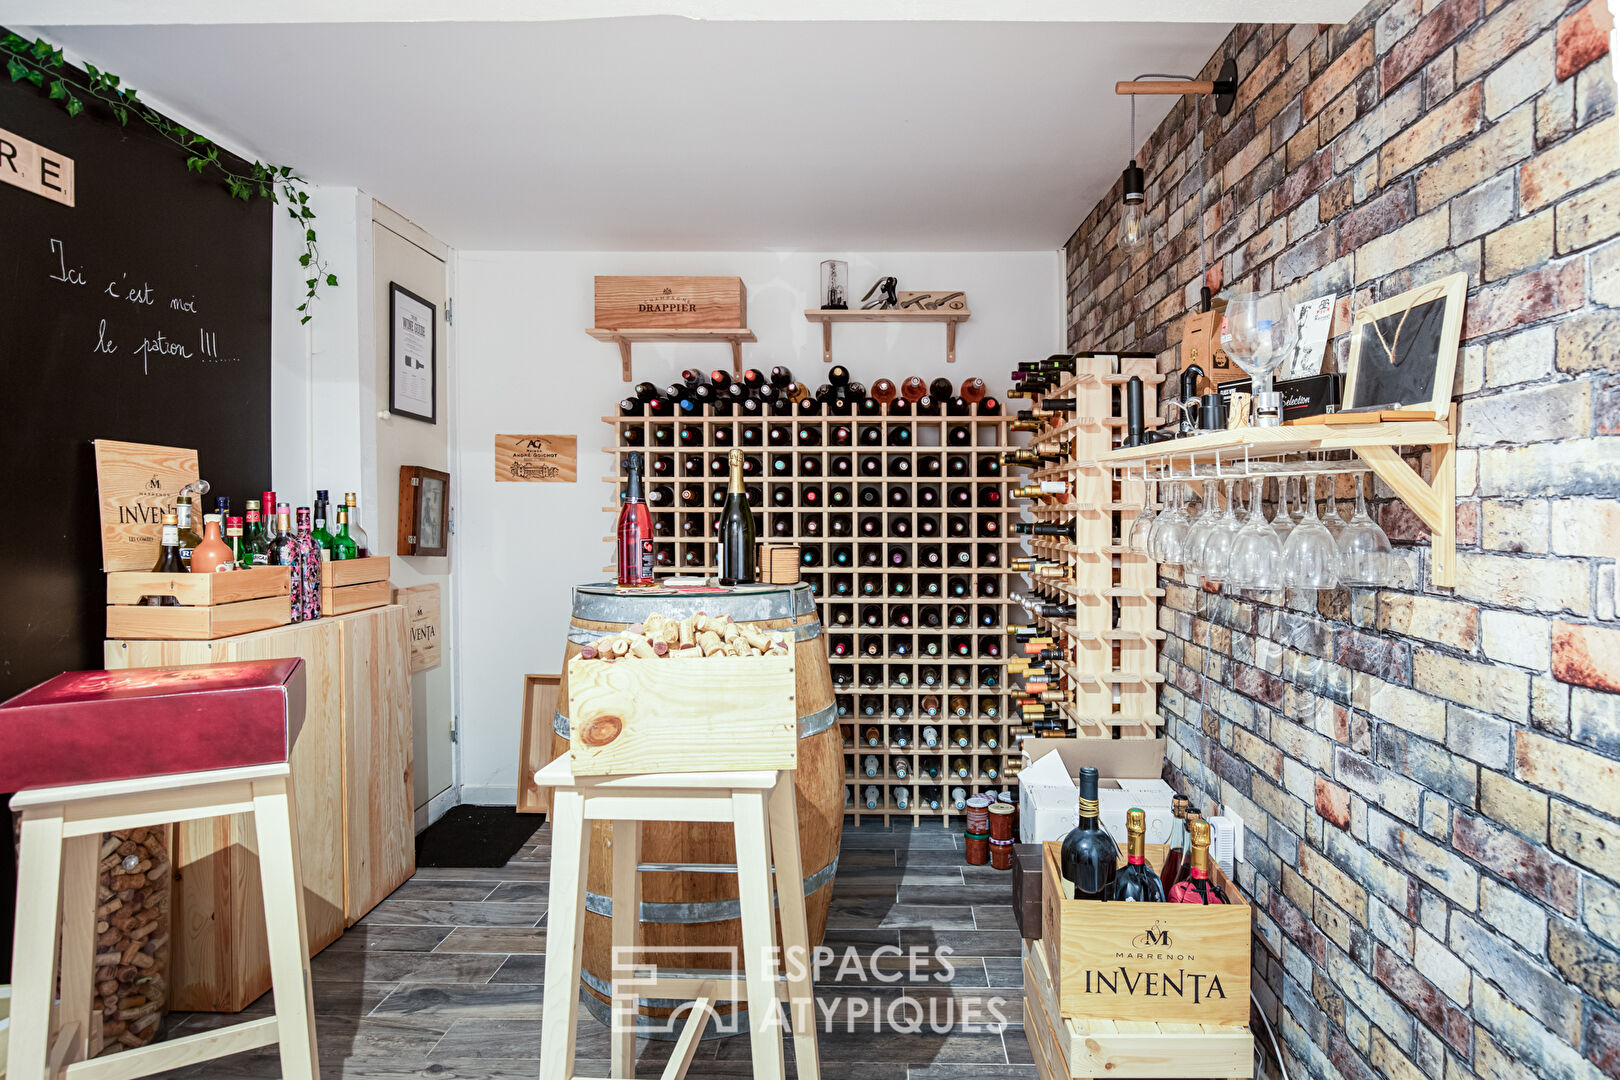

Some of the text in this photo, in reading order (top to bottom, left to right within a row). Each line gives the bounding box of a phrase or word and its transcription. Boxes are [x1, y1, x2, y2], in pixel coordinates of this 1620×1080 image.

[49, 238, 197, 314] Ici c'est moi
[638, 303, 697, 313] DRAPPIER
[93, 318, 118, 354] le
[1115, 951, 1196, 962] MARRENON
[1085, 966, 1228, 1005] INVENTA
